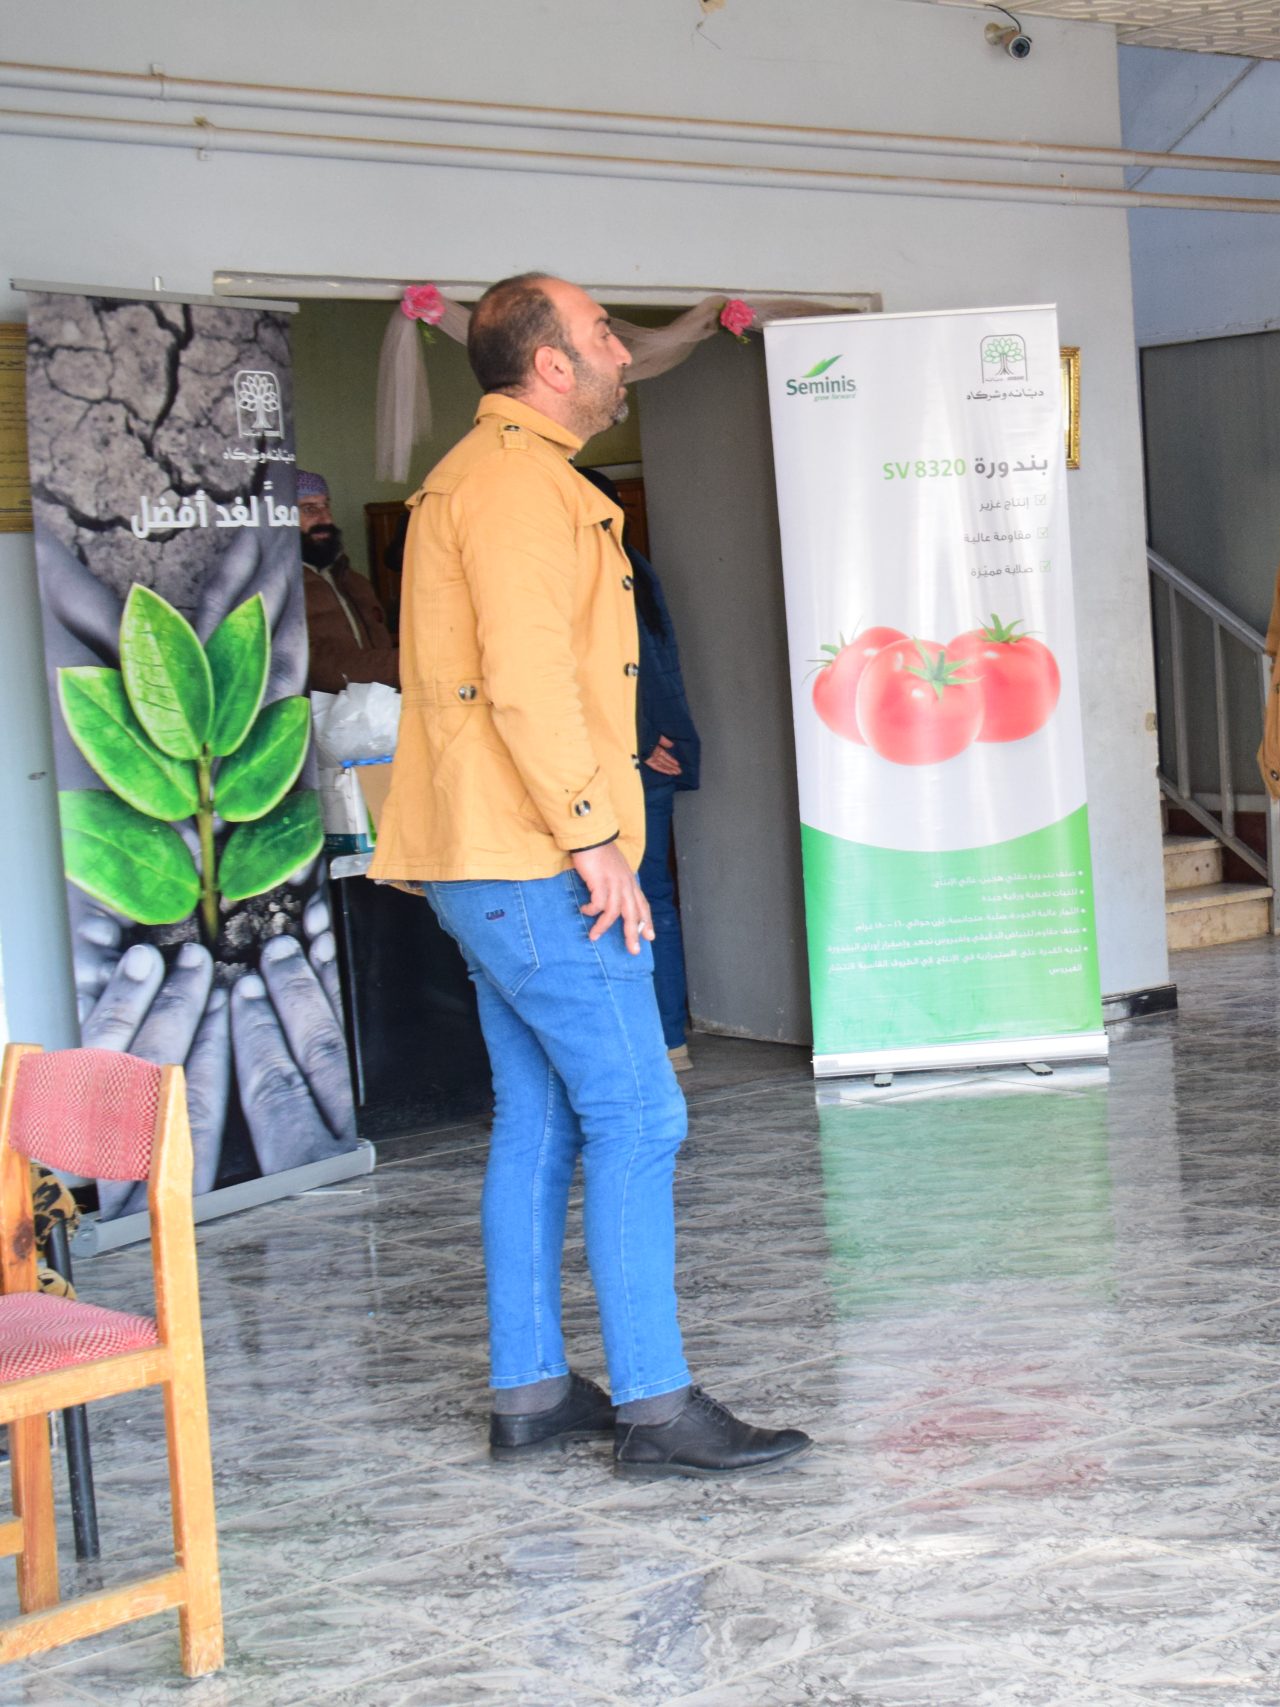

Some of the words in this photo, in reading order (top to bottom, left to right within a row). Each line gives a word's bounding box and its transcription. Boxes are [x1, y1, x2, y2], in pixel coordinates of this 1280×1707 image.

[786, 375, 857, 396] Seminis
[974, 454, 1049, 480] بندورة
[131, 489, 209, 539] أفضل
[214, 495, 261, 528] لغد
[993, 530, 1032, 544] مقاومة
